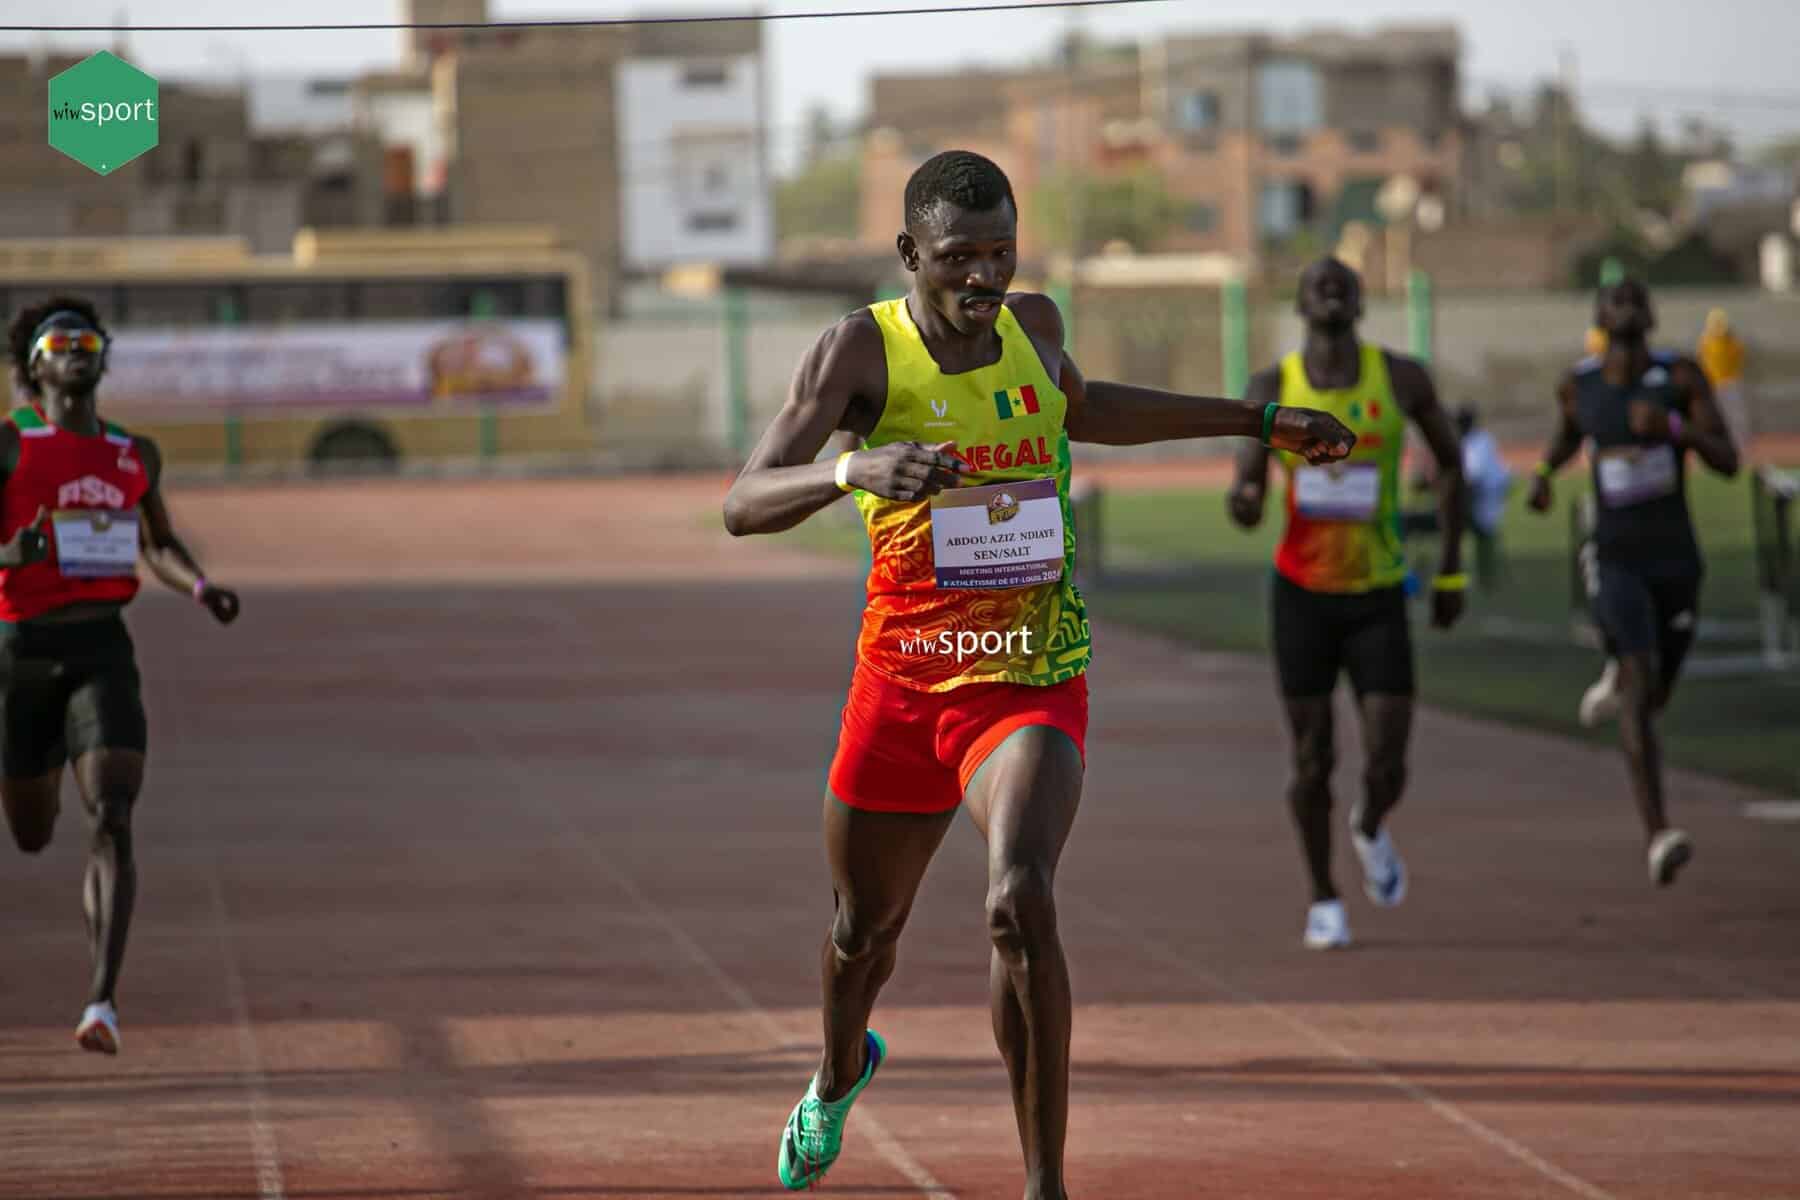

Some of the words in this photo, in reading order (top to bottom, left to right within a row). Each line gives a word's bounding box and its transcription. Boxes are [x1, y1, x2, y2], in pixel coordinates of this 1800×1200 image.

[946, 436, 1053, 473] NEGAL
[946, 535, 988, 547] ABDOU
[990, 533, 1017, 544] AZIZ
[1020, 528, 1056, 540] NDIAYE
[974, 546, 1031, 560] SEN/SALT
[959, 568, 993, 576] MEETING
